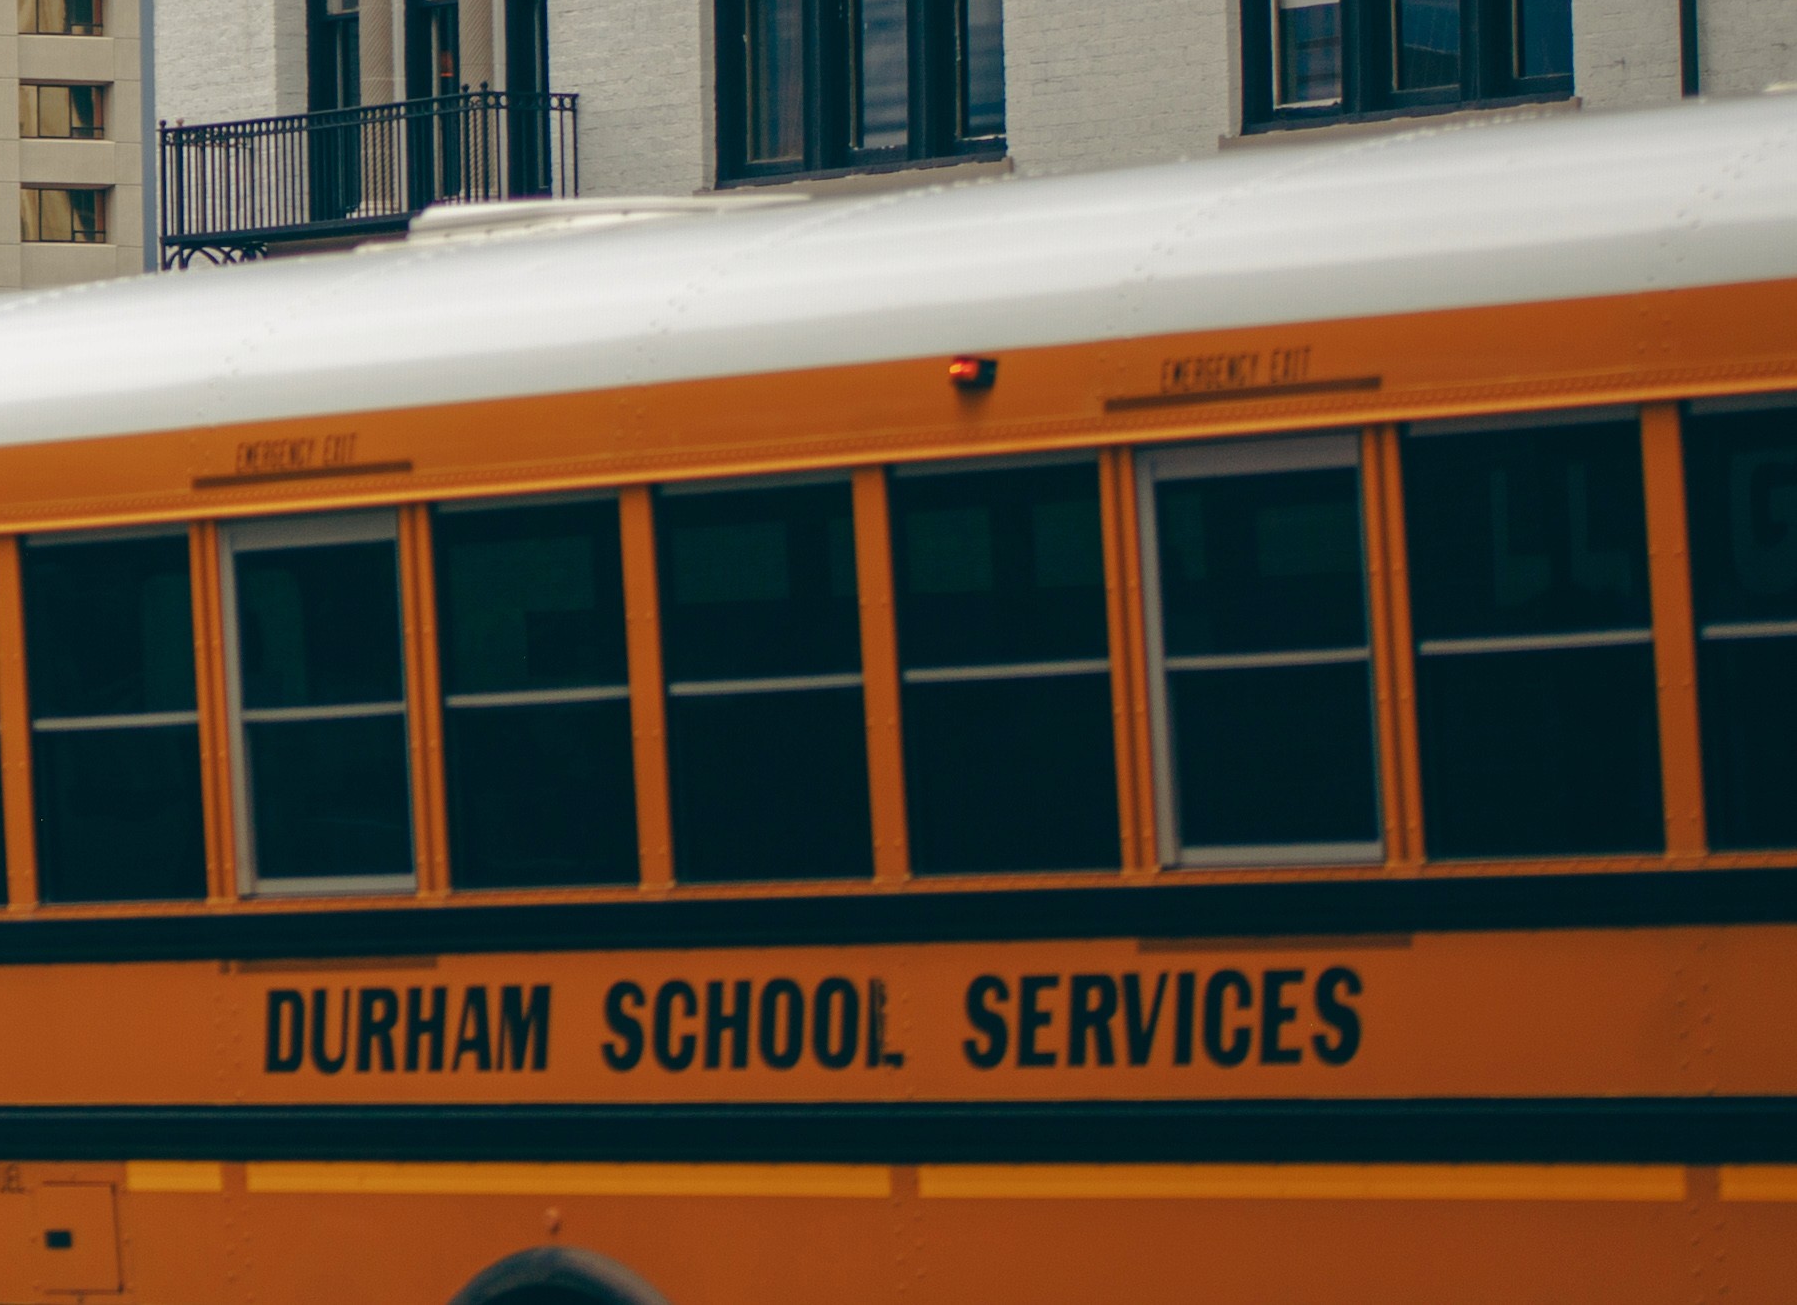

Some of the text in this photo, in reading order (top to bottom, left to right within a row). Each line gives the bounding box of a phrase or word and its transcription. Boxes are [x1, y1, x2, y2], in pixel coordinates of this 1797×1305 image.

[1160, 345, 1312, 394] EMERGENCY EXIT
[322, 432, 358, 466] EXIT
[263, 964, 1364, 1075] DURHAM SCHOOL SERVICES
